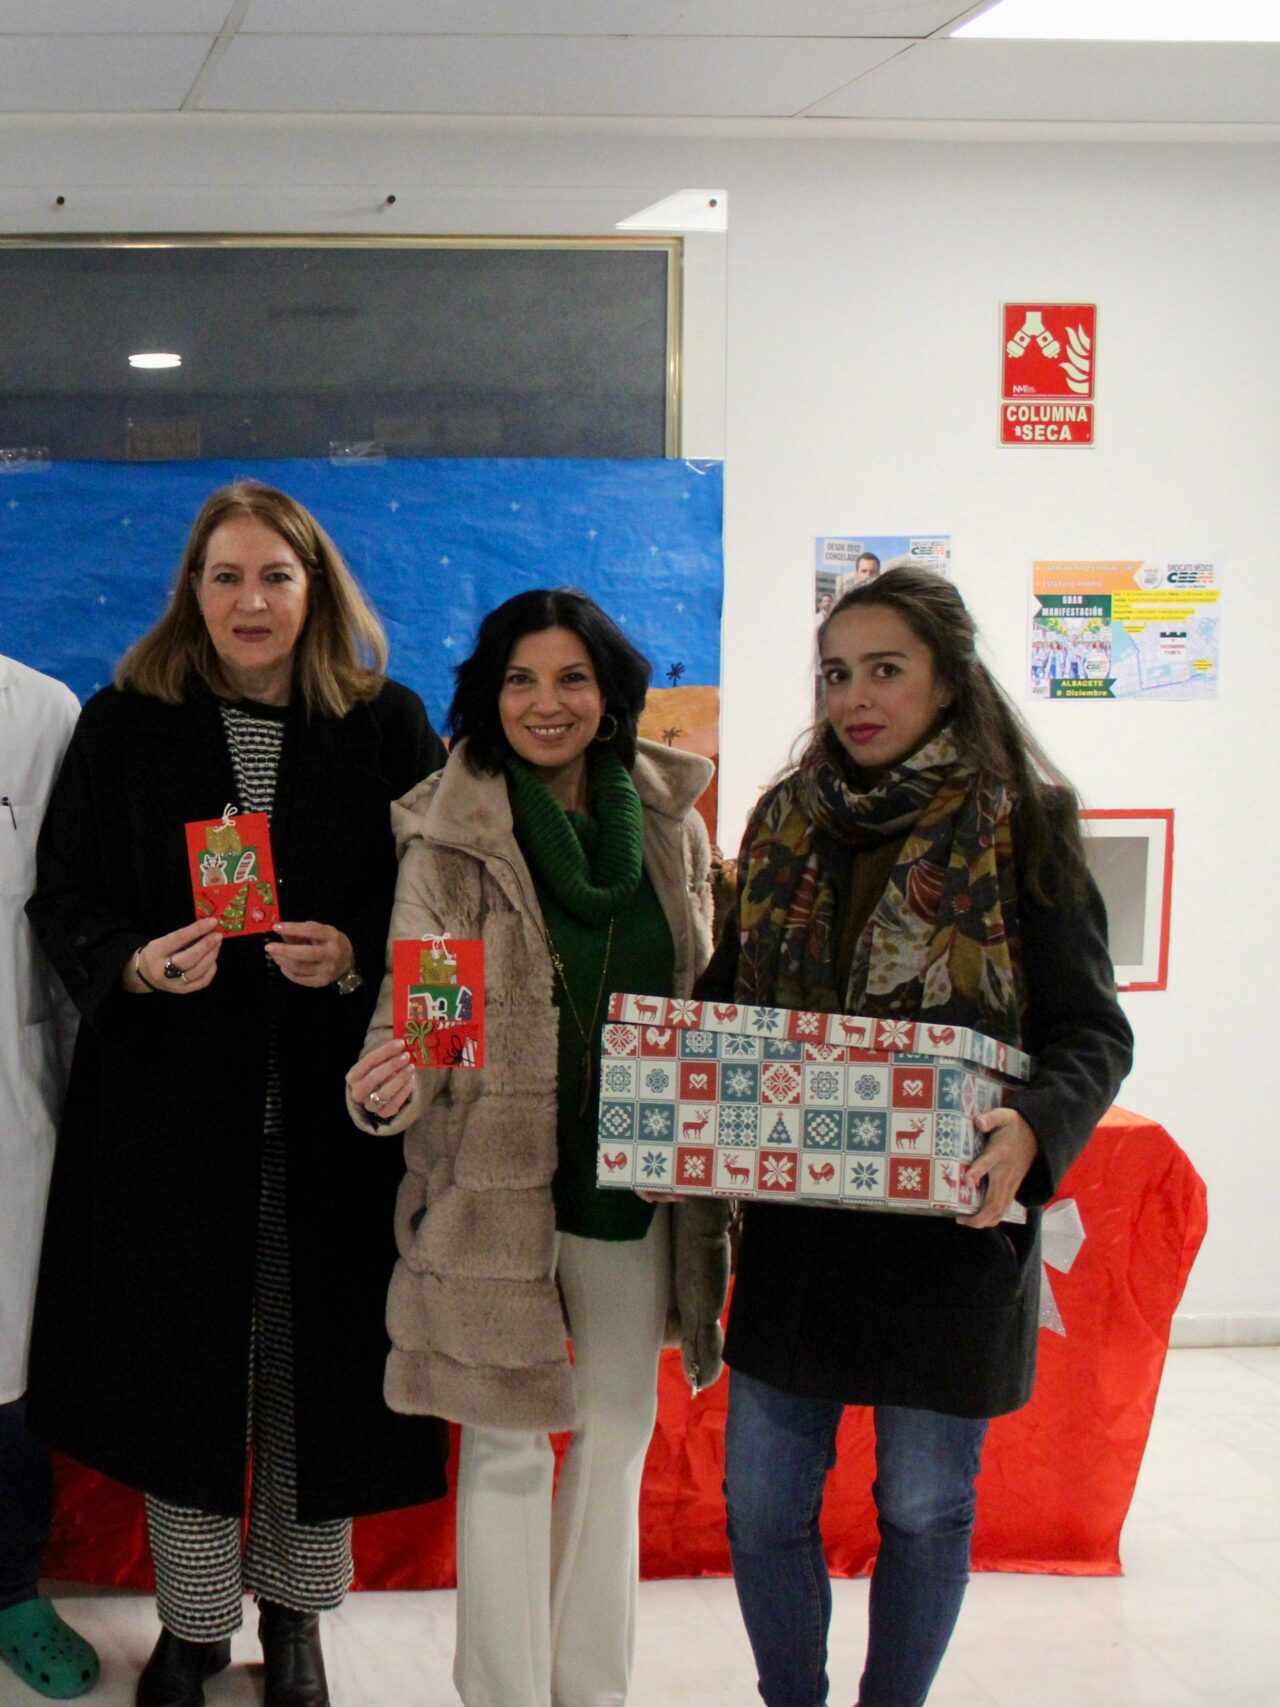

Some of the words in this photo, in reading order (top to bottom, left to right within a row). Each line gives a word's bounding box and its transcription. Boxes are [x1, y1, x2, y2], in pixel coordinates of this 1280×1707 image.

[1006, 405, 1088, 422] COLUMNA
[1022, 424, 1072, 441] SECA
[827, 542, 845, 551] DESDE
[1167, 564, 1193, 572] SINDICATO
[1062, 595, 1083, 605] GRAN
[1041, 606, 1103, 617] MANIFESTACIÓN
[1066, 689, 1107, 697] Diciembre
